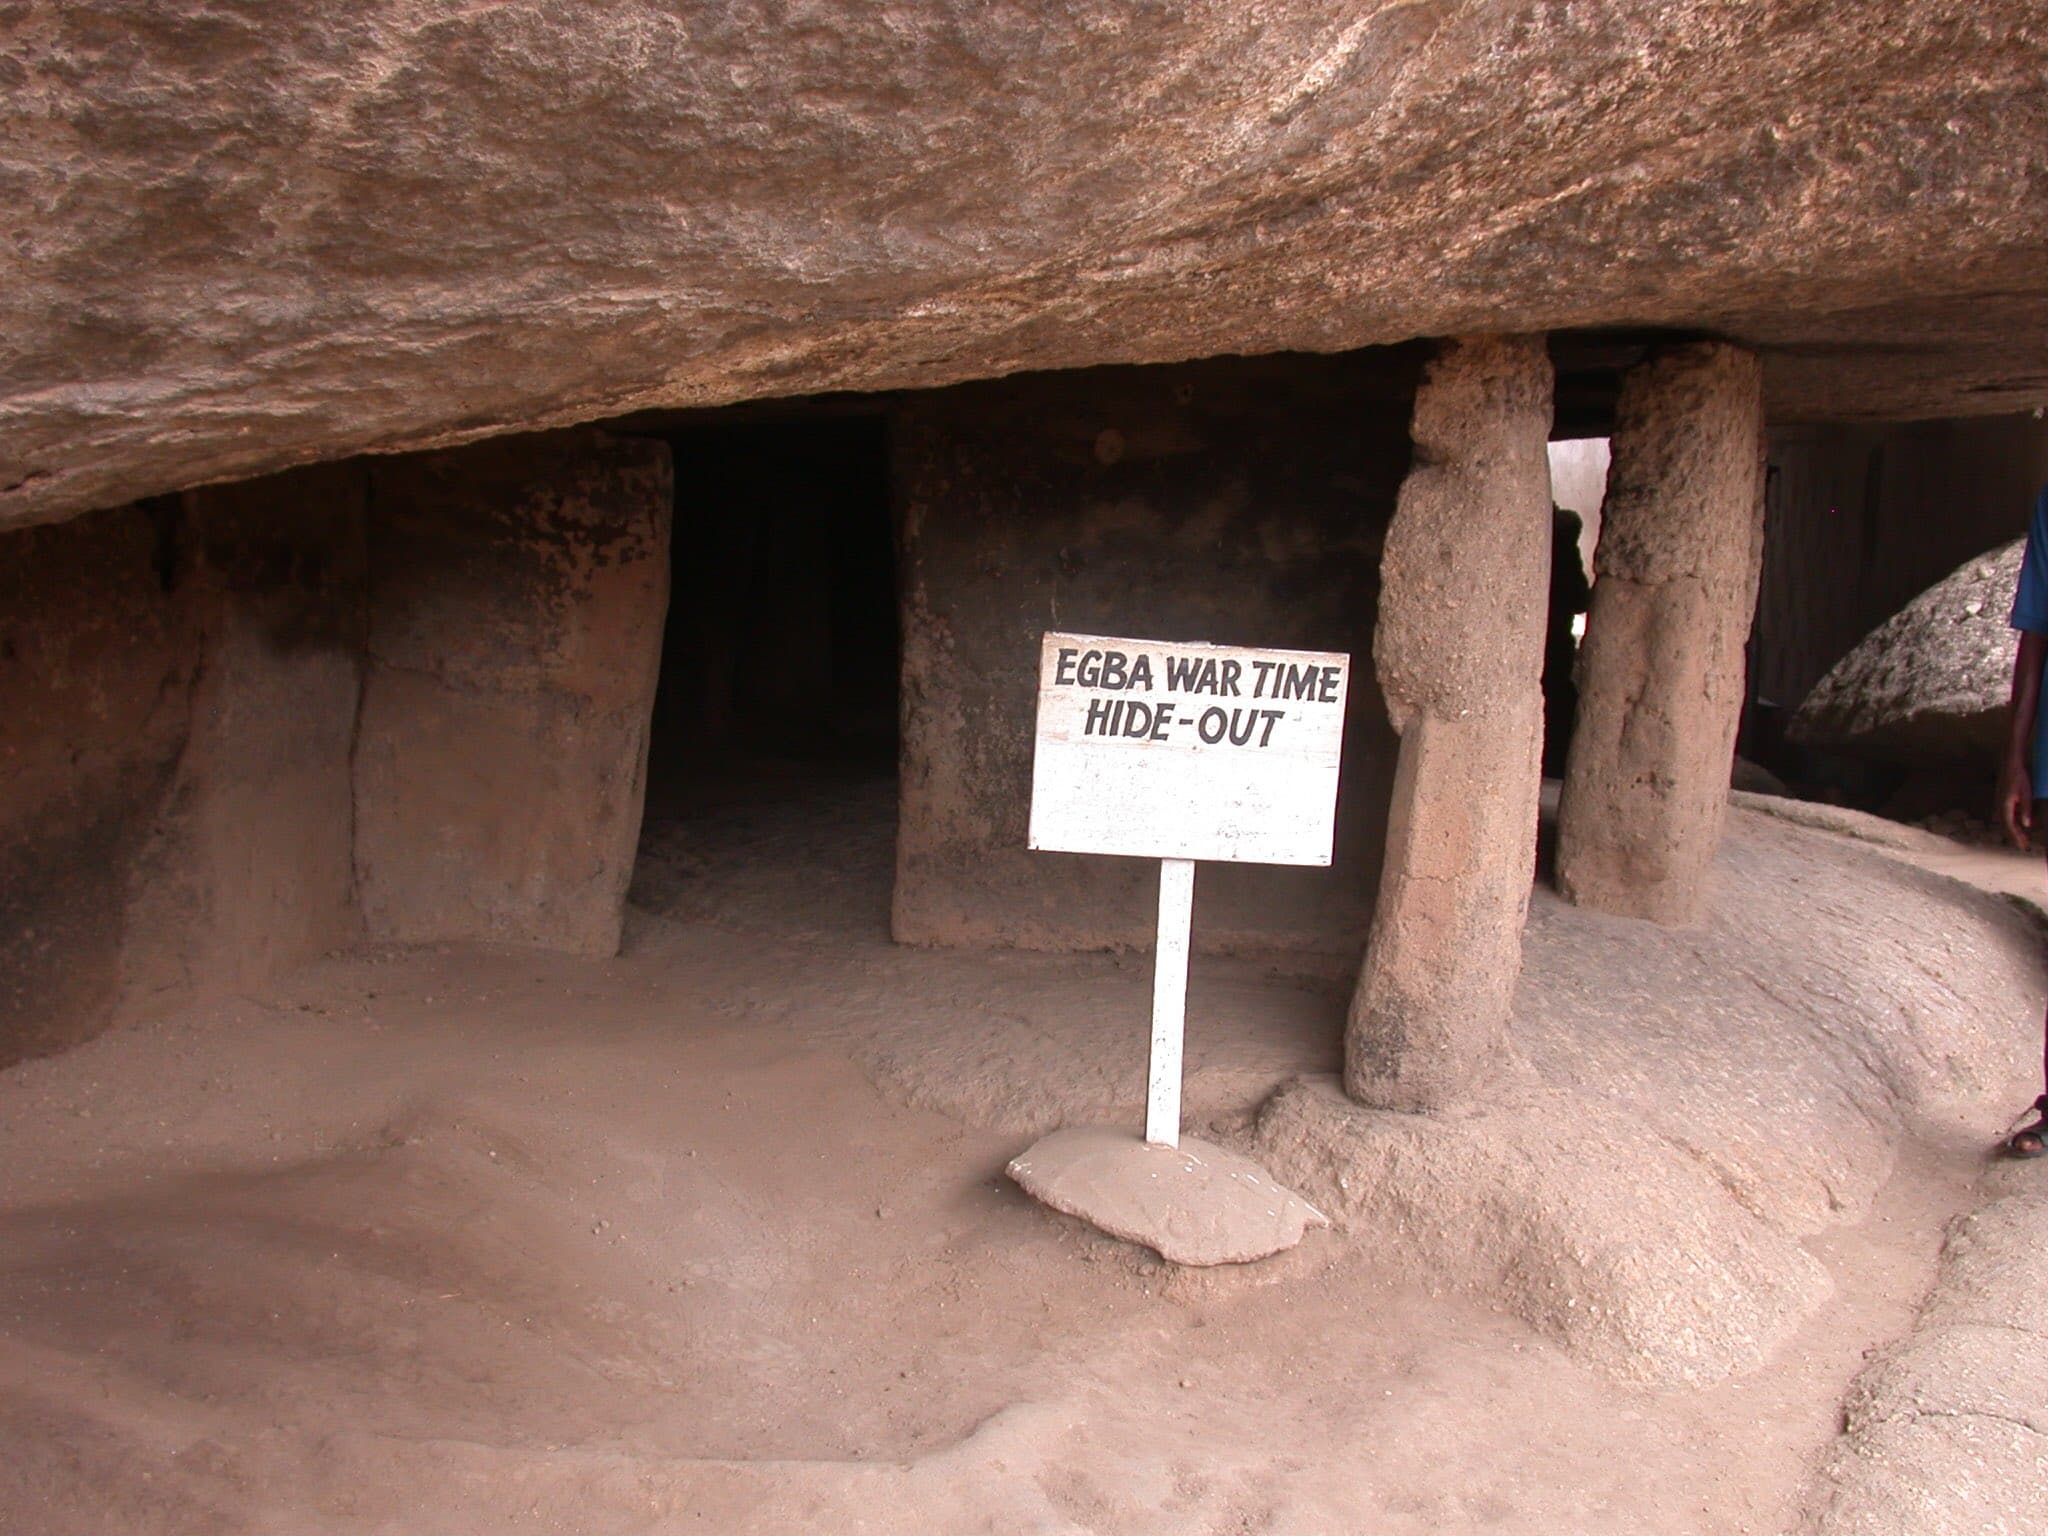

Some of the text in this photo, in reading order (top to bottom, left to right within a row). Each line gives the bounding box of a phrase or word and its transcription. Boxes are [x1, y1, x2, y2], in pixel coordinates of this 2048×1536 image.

[1055, 648, 1342, 703] EGBA WAR TIME
[1084, 698, 1286, 748] HIDE-OUT
